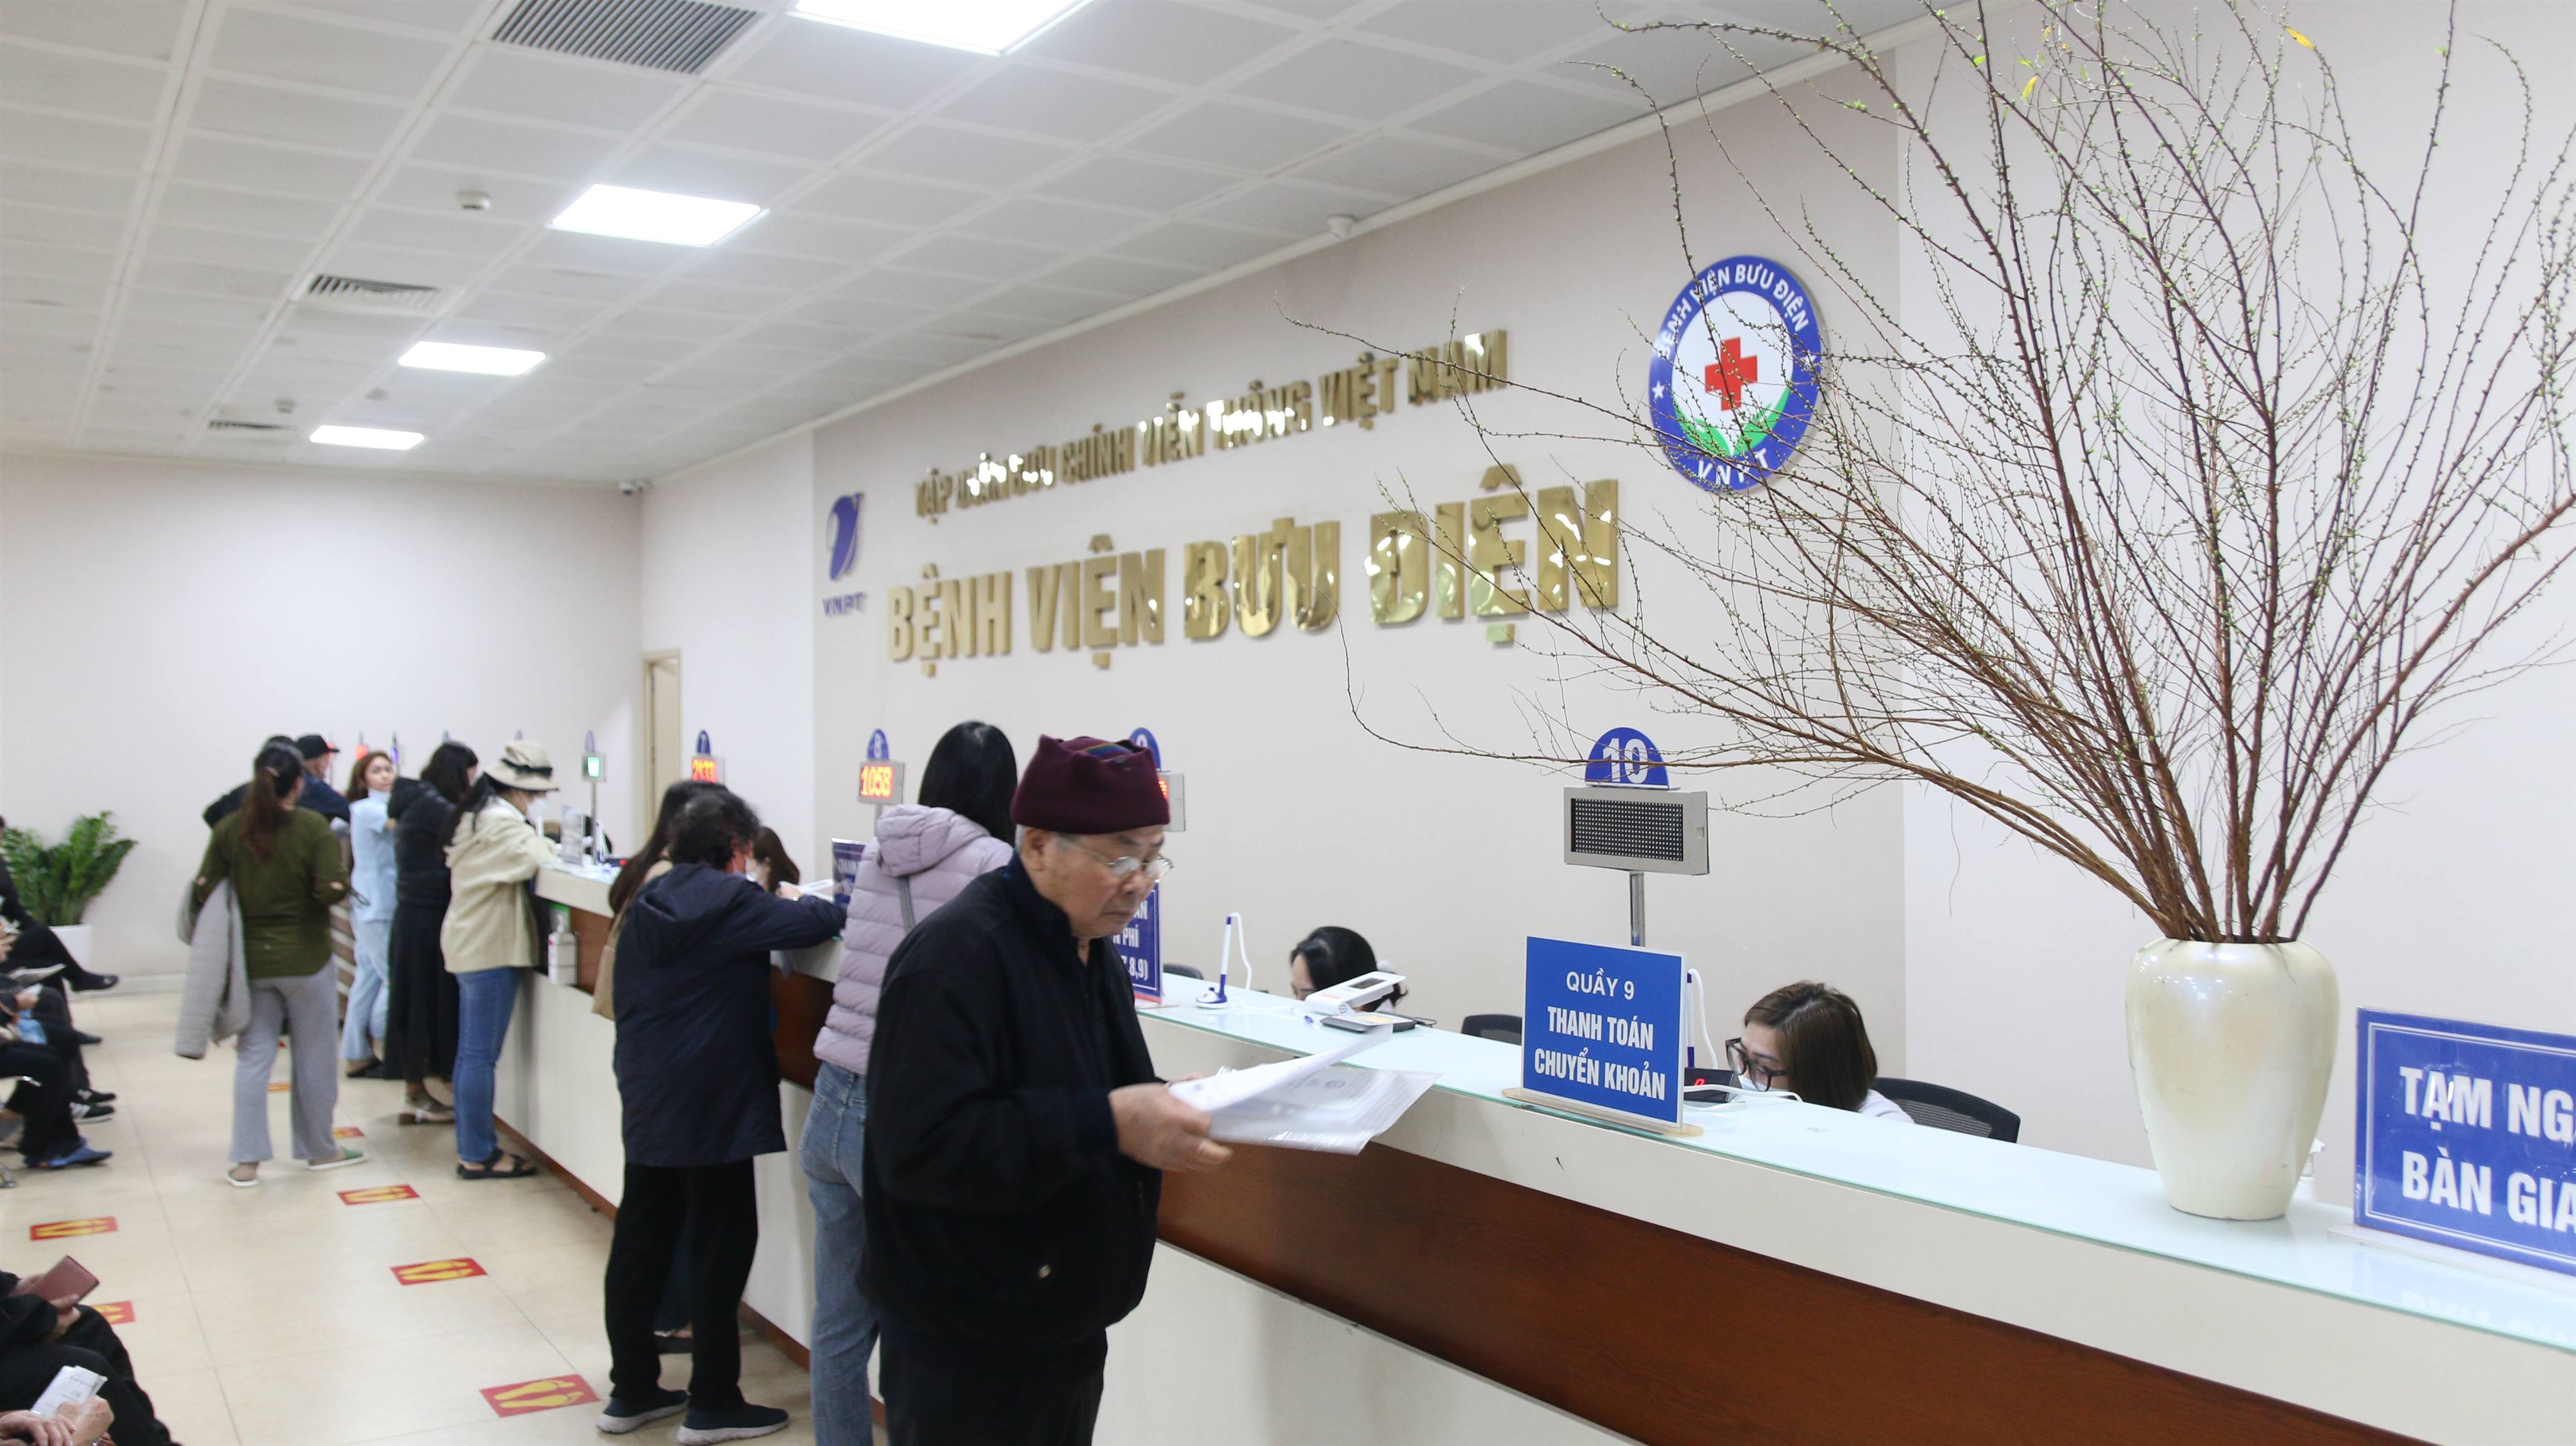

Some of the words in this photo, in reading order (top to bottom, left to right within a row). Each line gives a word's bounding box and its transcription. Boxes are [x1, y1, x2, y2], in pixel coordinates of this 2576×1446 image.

[1735, 263, 1775, 290] BƯU
[1773, 279, 1810, 333] ĐIỆN
[1060, 423, 1136, 484] CHÍNH
[1318, 351, 1399, 431] VIỆT
[1406, 329, 1508, 406] NAM
[1698, 447, 1768, 486] VNPT
[822, 591, 866, 617] VNPT
[887, 562, 1013, 677] BỆNH
[1025, 533, 1166, 669] VIỆN
[1183, 516, 1341, 640] BƯU
[1602, 737, 1648, 784] 10
[1122, 924, 1140, 948] PHÍ
[1566, 967, 1619, 998] QUẦY
[1624, 981, 1635, 1001] 9
[1547, 1006, 1602, 1042] THANH
[1607, 1015, 1654, 1052] TOÁN
[1534, 1047, 1601, 1087] CHUYỂN
[1604, 1060, 1666, 1101] KHOẢN
[2399, 1066, 2492, 1131] TẠM
[2507, 1082, 2576, 1144] NG
[2402, 1146, 2492, 1217] BÀN
